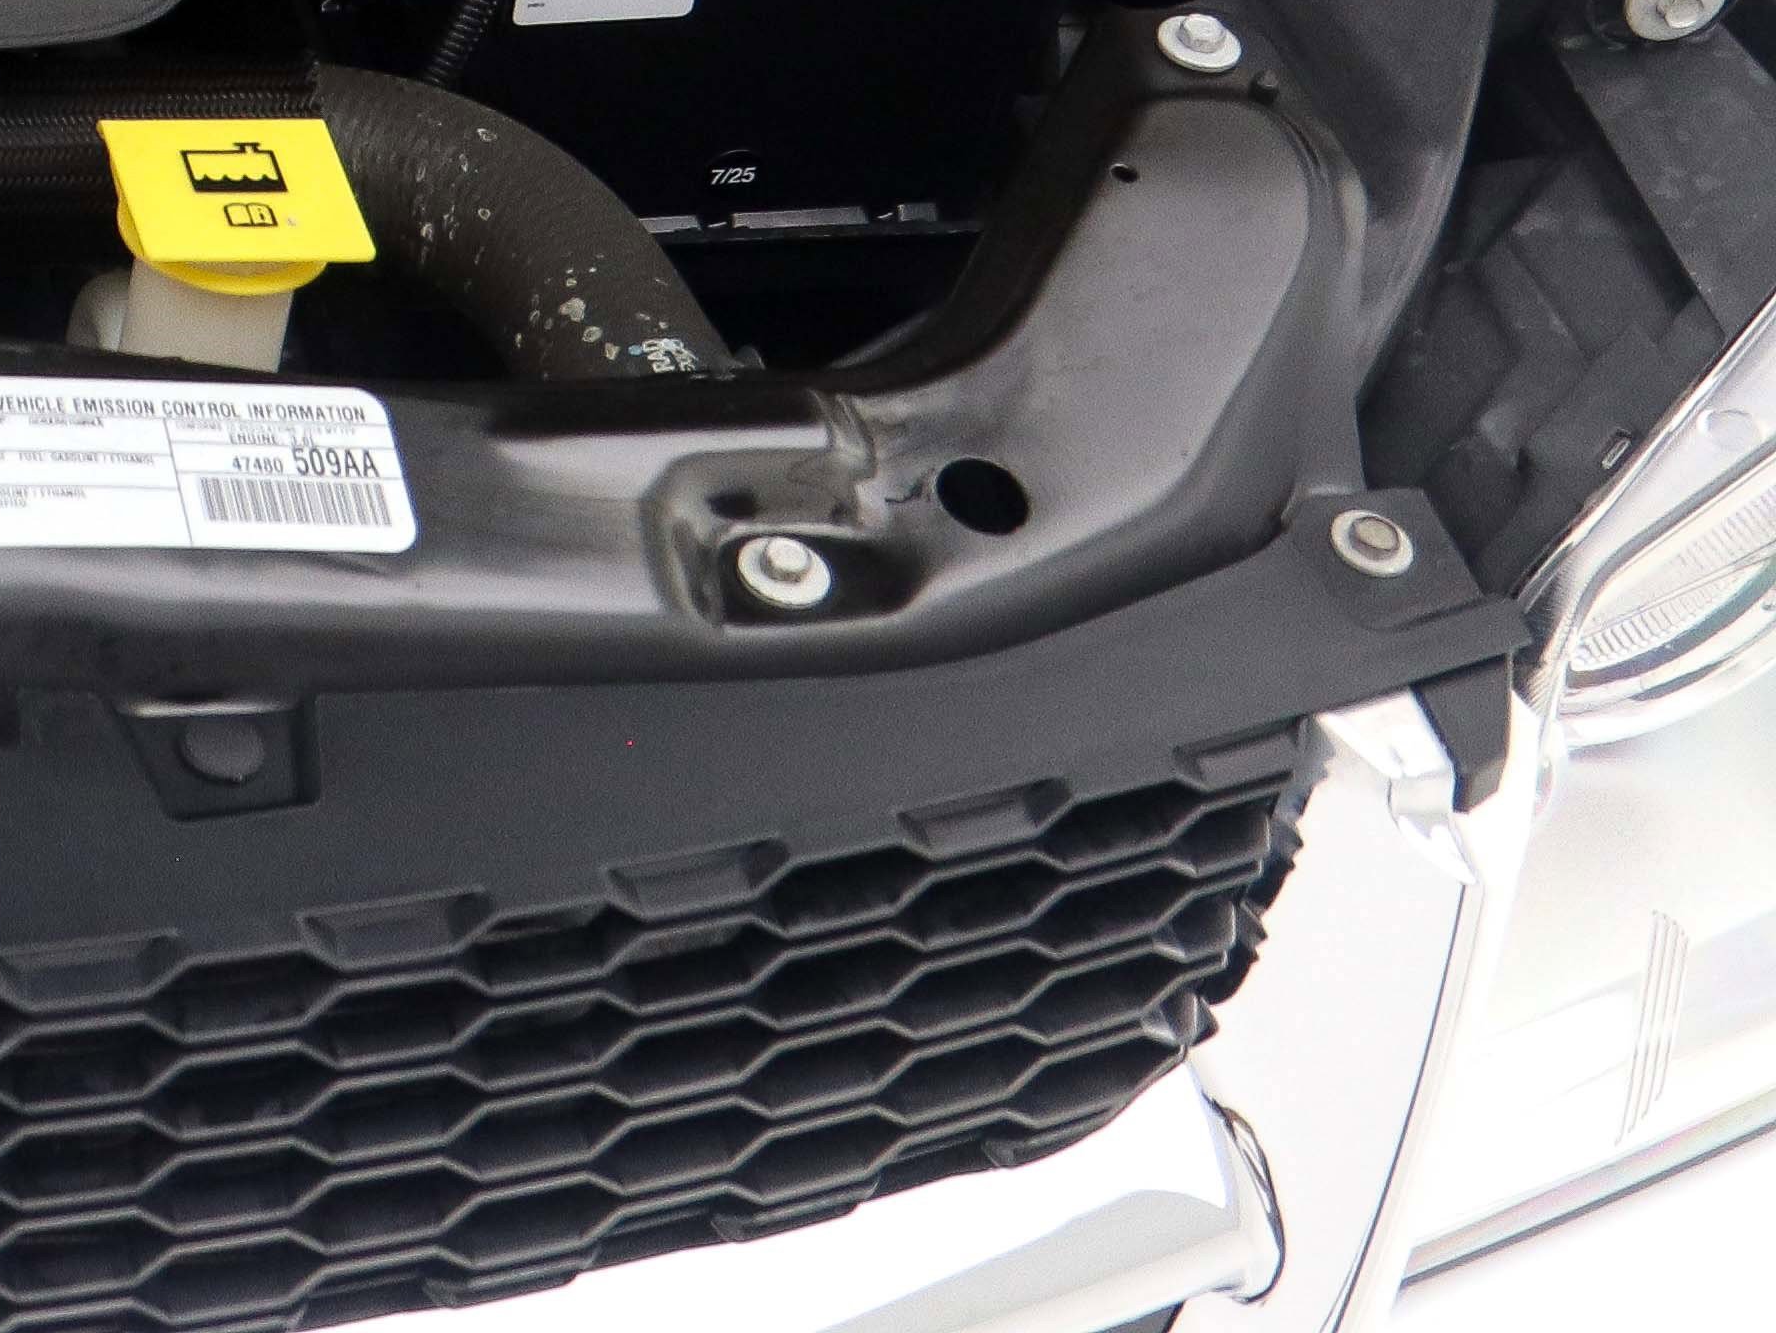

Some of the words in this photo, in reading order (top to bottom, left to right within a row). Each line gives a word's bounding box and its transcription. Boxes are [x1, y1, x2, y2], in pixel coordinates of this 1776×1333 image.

[710, 165, 758, 186] 7/25
[72, 397, 155, 416] EMISSION
[161, 399, 241, 418] CONTROL
[247, 403, 366, 423] INFORMATION
[292, 447, 381, 478] 509AA
